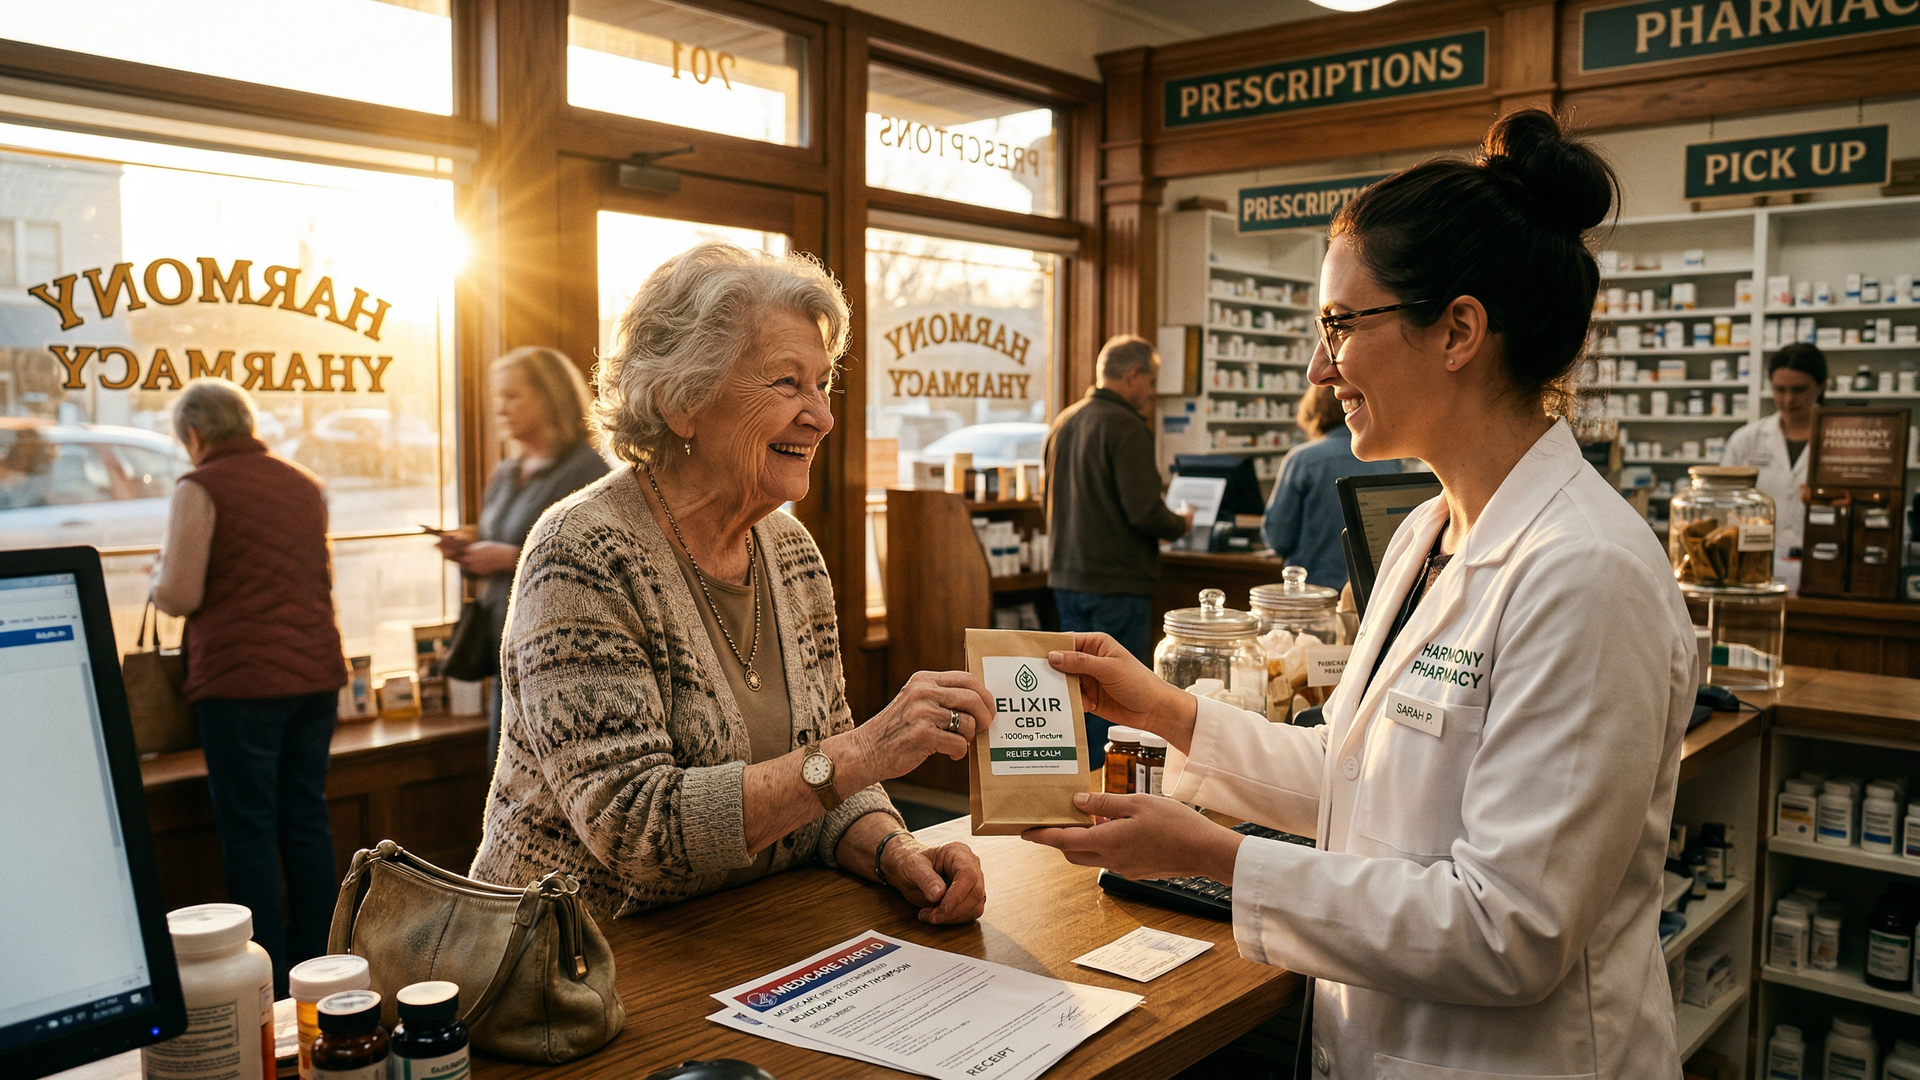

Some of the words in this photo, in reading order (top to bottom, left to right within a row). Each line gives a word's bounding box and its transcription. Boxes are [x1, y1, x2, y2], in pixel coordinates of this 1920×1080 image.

[1179, 43, 1464, 118] PRESCRIPTIONS
[1705, 146, 1797, 186] PICK
[1810, 140, 1867, 176] UP
[1421, 642, 1484, 668] HARMONY
[1410, 660, 1484, 689] PHARMACY
[995, 697, 1062, 713] ELIXIR
[1396, 703, 1424, 721] SARAH
[1425, 713, 1433, 724] P.
[1015, 717, 1047, 728] CBD
[1034, 732, 1063, 740] Tincture
[1006, 750, 1031, 758] RELIEF
[1040, 749, 1061, 757] CALM
[770, 962, 842, 996] MEDICARE
[837, 947, 873, 965] PART
[870, 942, 885, 950] D
[966, 1046, 1015, 1076] RECEIPT
